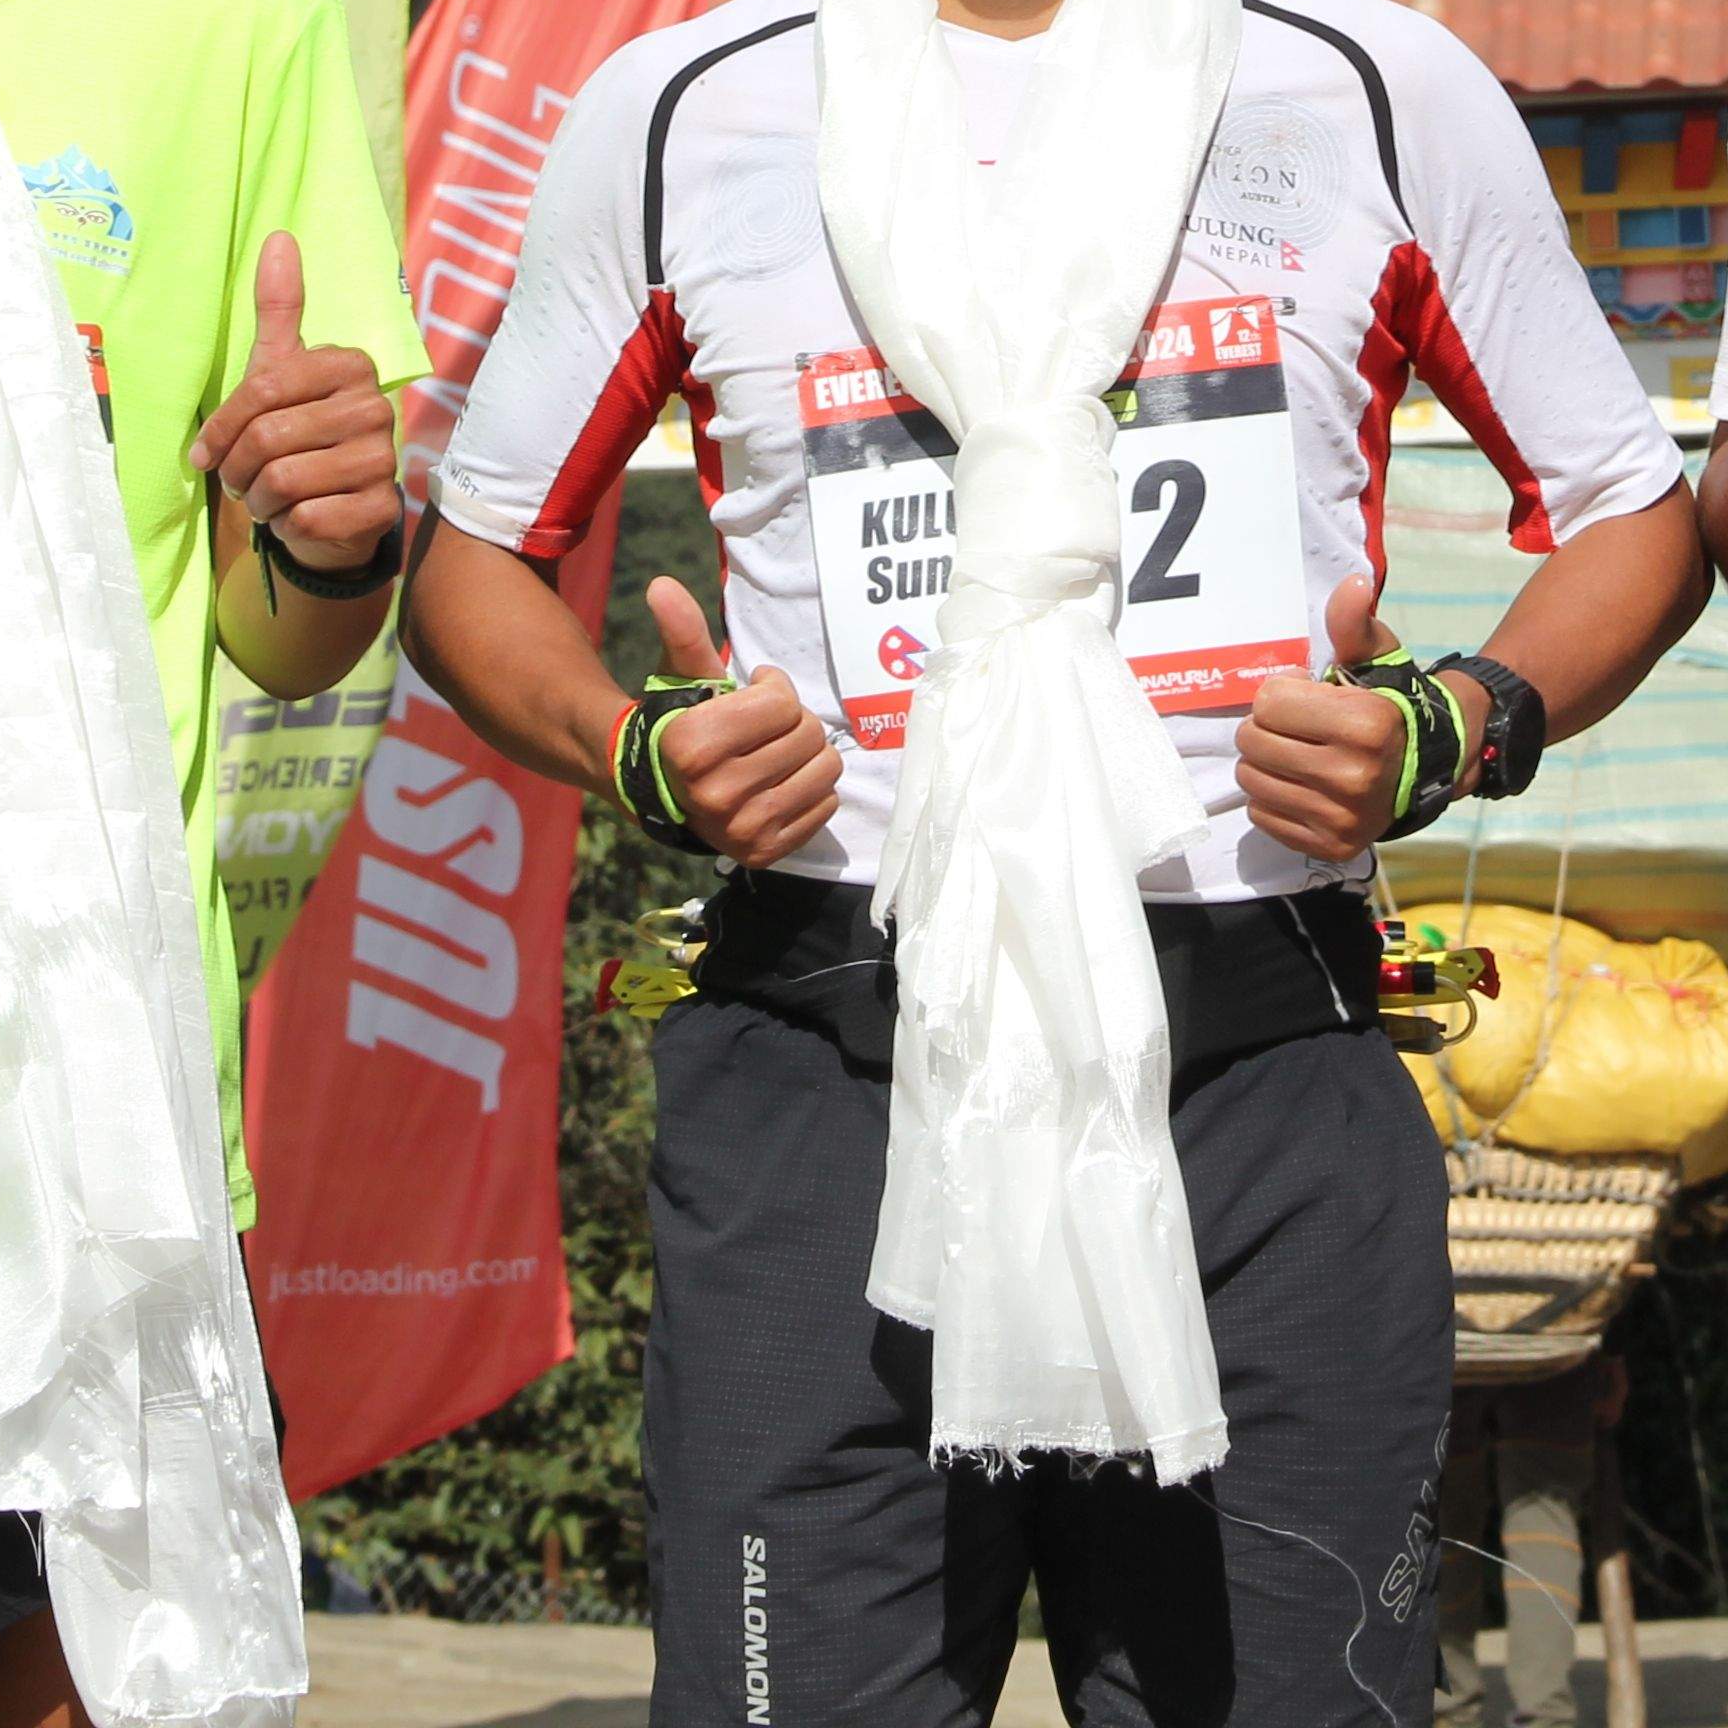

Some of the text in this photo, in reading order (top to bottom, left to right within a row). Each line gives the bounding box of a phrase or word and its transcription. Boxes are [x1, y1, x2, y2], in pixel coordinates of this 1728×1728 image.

[1240, 191, 1302, 208] AUSTR
[1209, 243, 1272, 269] NEPAL
[1127, 458, 1207, 606] 2
[268, 1253, 539, 1303] justloading.com
[742, 1533, 770, 1727] SALOMON
